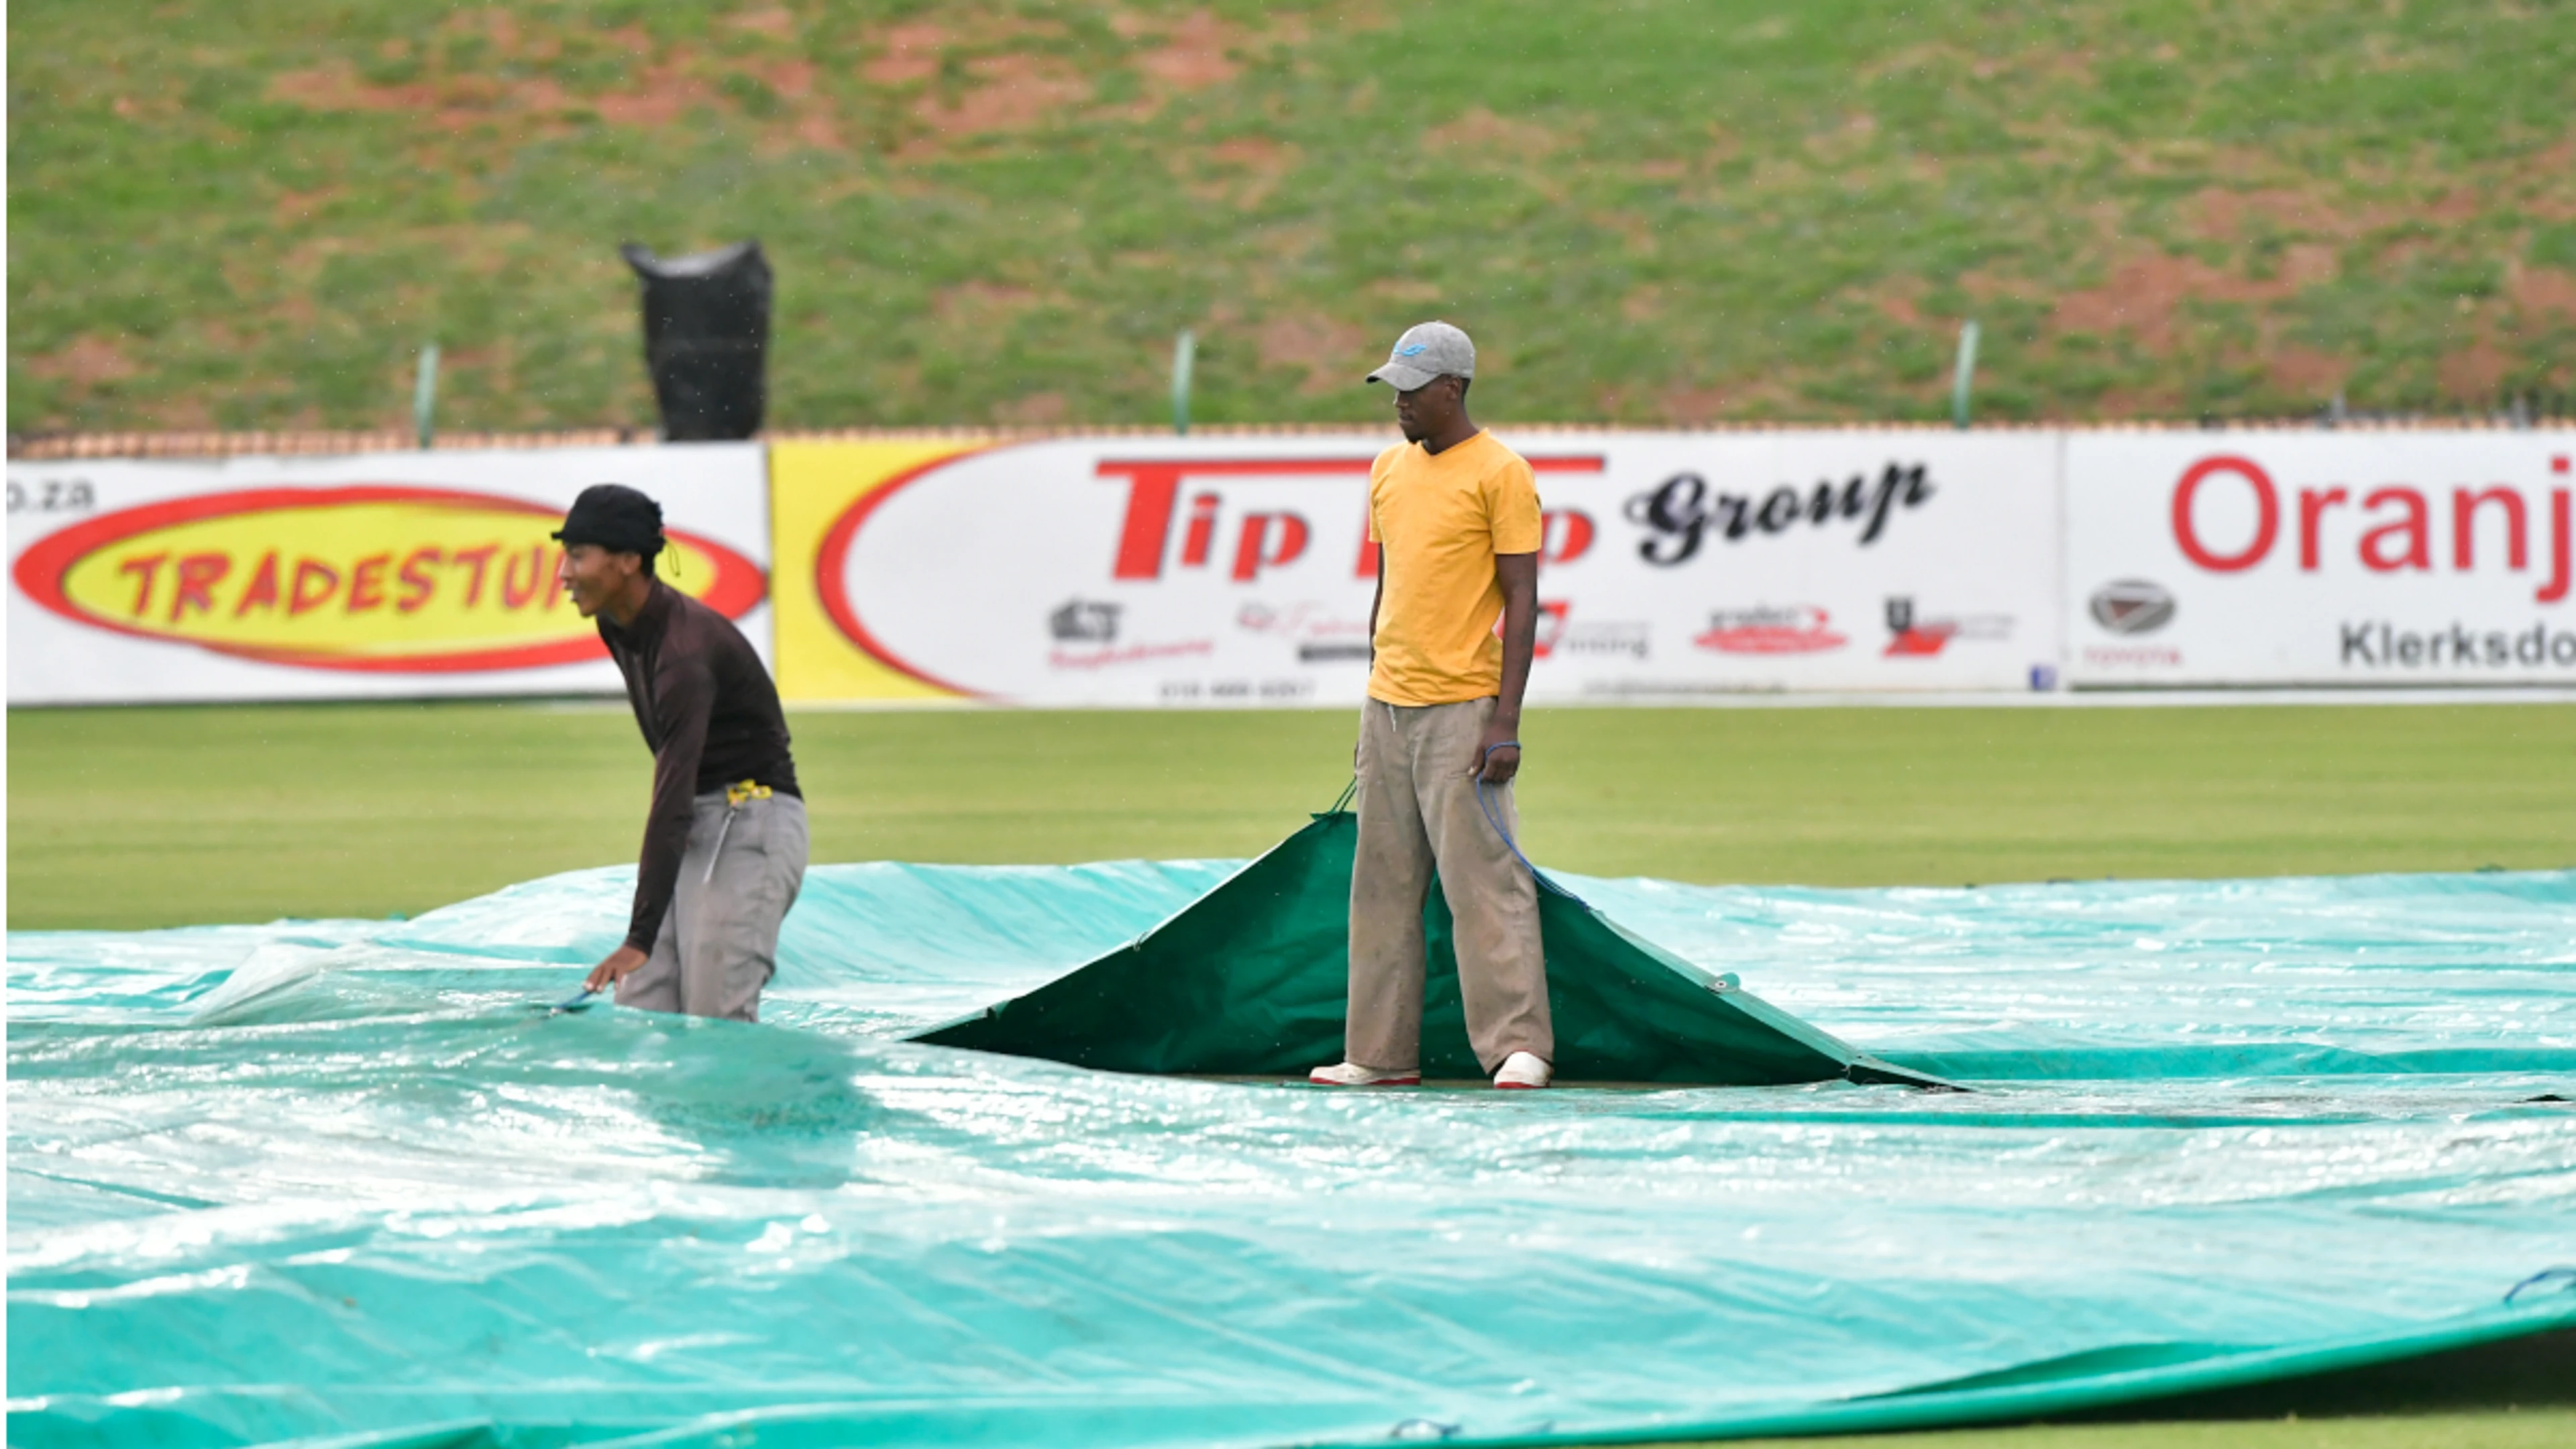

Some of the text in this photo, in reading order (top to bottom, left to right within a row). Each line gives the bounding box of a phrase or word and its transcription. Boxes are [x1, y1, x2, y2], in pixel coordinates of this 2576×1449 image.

[1095, 458, 1311, 581] Tip
[1623, 462, 1936, 568] Group
[2171, 453, 2571, 604] Oranj
[2340, 621, 2576, 667] Klerksdo
